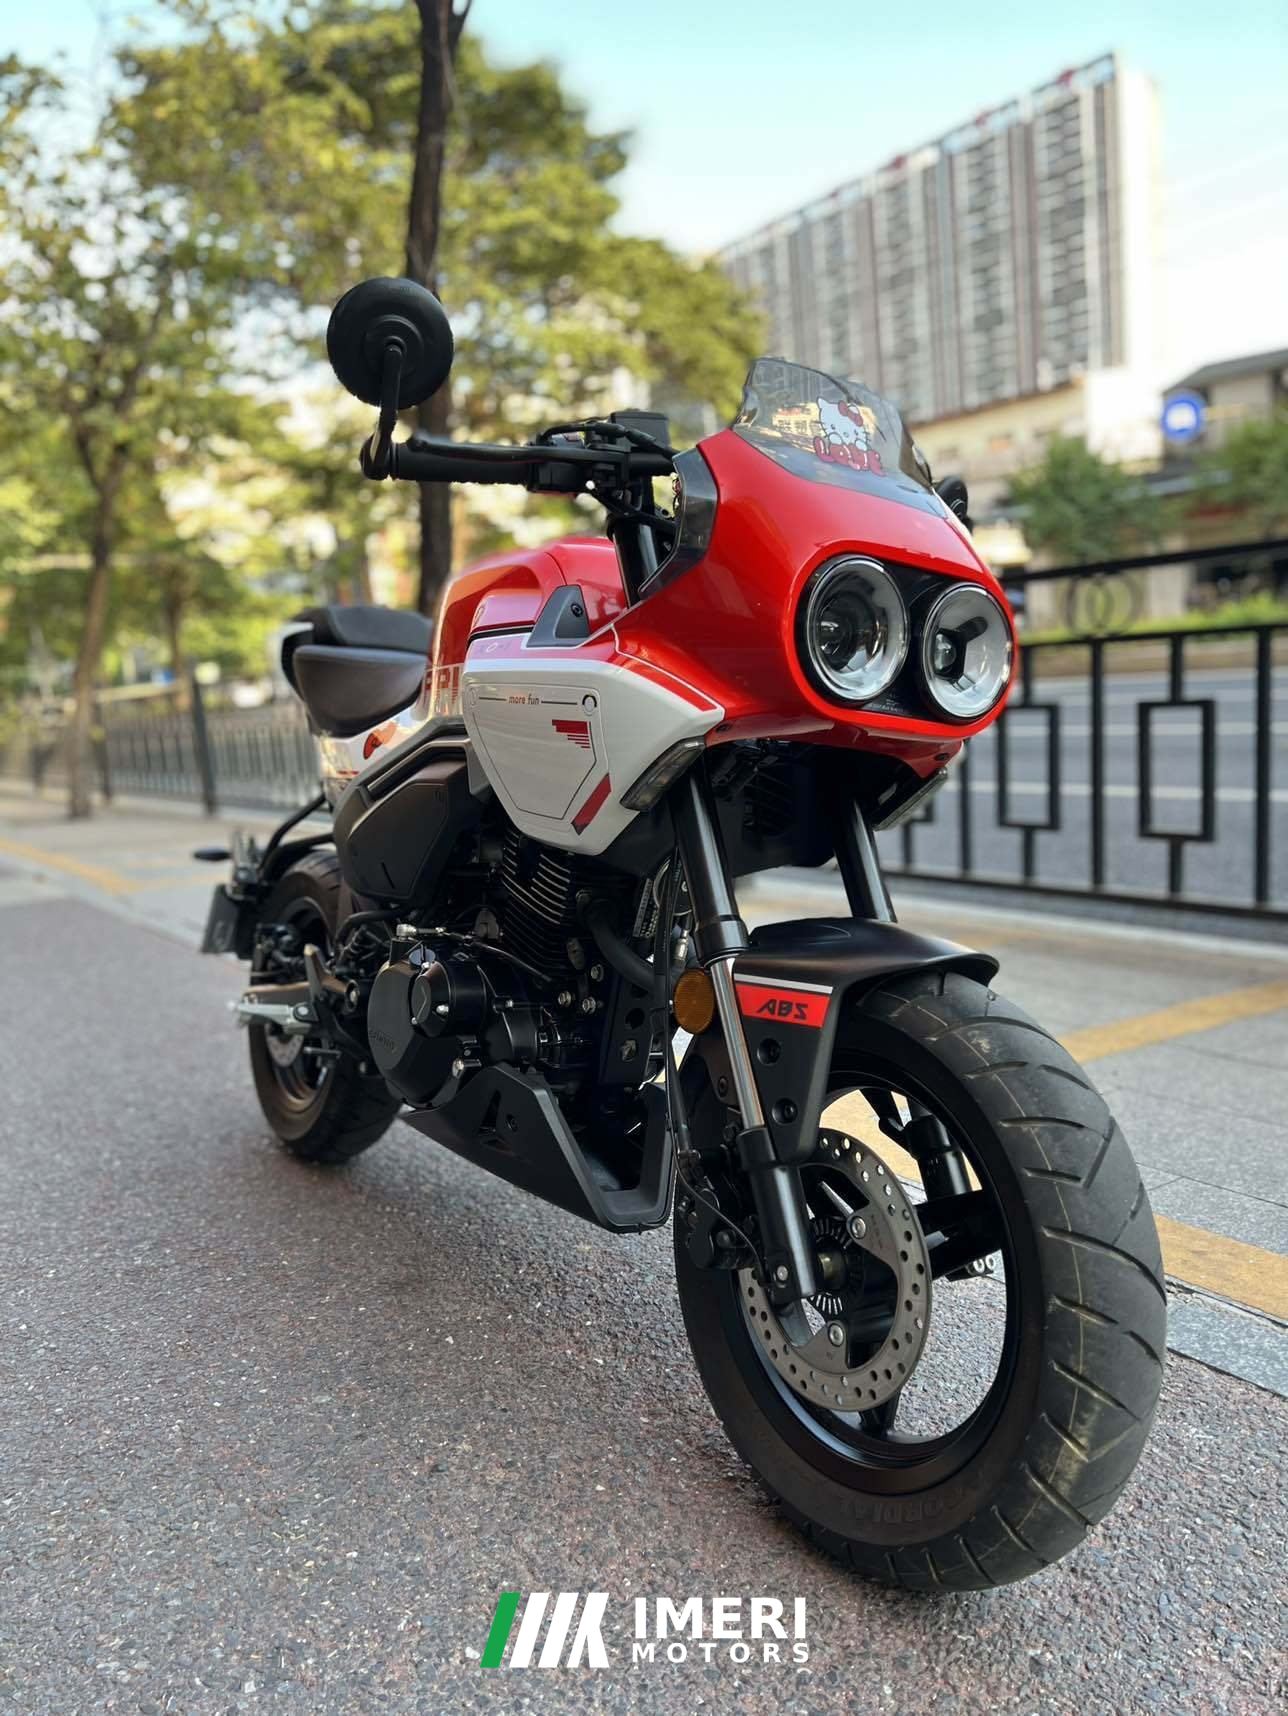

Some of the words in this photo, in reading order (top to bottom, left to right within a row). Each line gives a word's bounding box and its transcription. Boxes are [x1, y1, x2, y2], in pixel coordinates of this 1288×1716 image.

[508, 696, 526, 705] more
[527, 693, 540, 705] fun
[756, 999, 808, 1020] ABS
